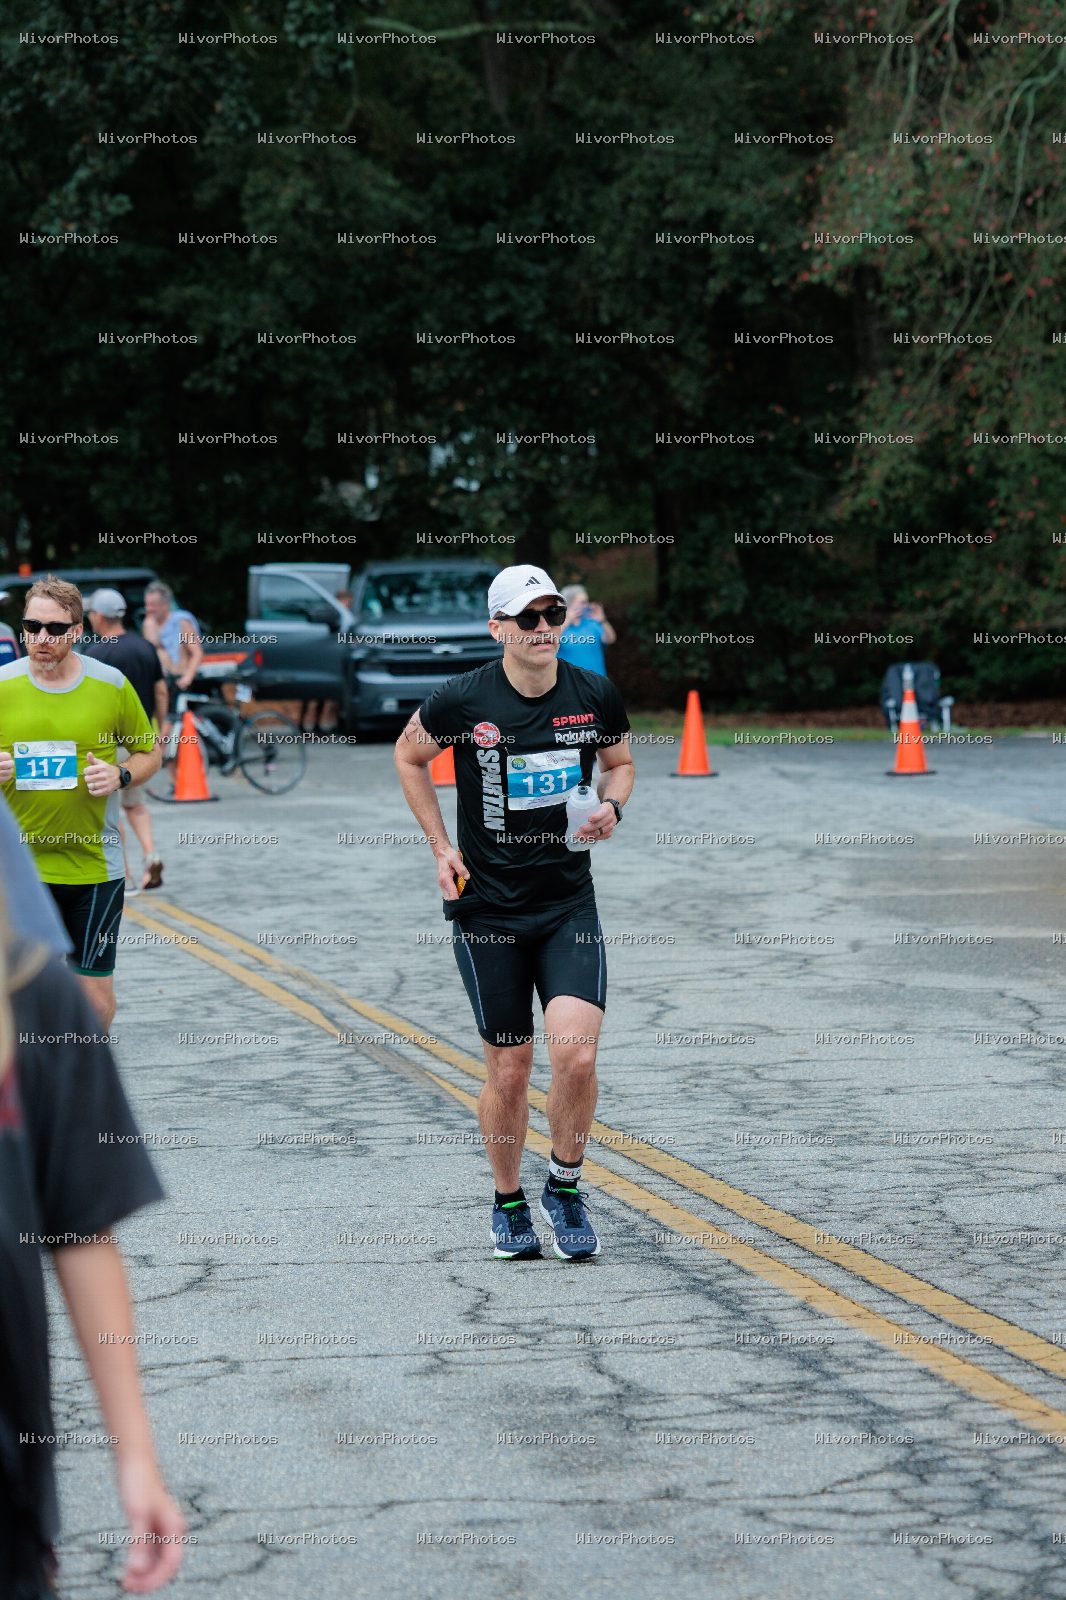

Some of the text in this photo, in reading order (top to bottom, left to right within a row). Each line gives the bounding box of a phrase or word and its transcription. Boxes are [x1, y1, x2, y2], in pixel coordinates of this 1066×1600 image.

[552, 713, 595, 727] SPRINT
[554, 729, 598, 745] Rakuten
[26, 757, 67, 777] 117
[476, 749, 506, 831] SPARTAN
[522, 770, 568, 795] 131
